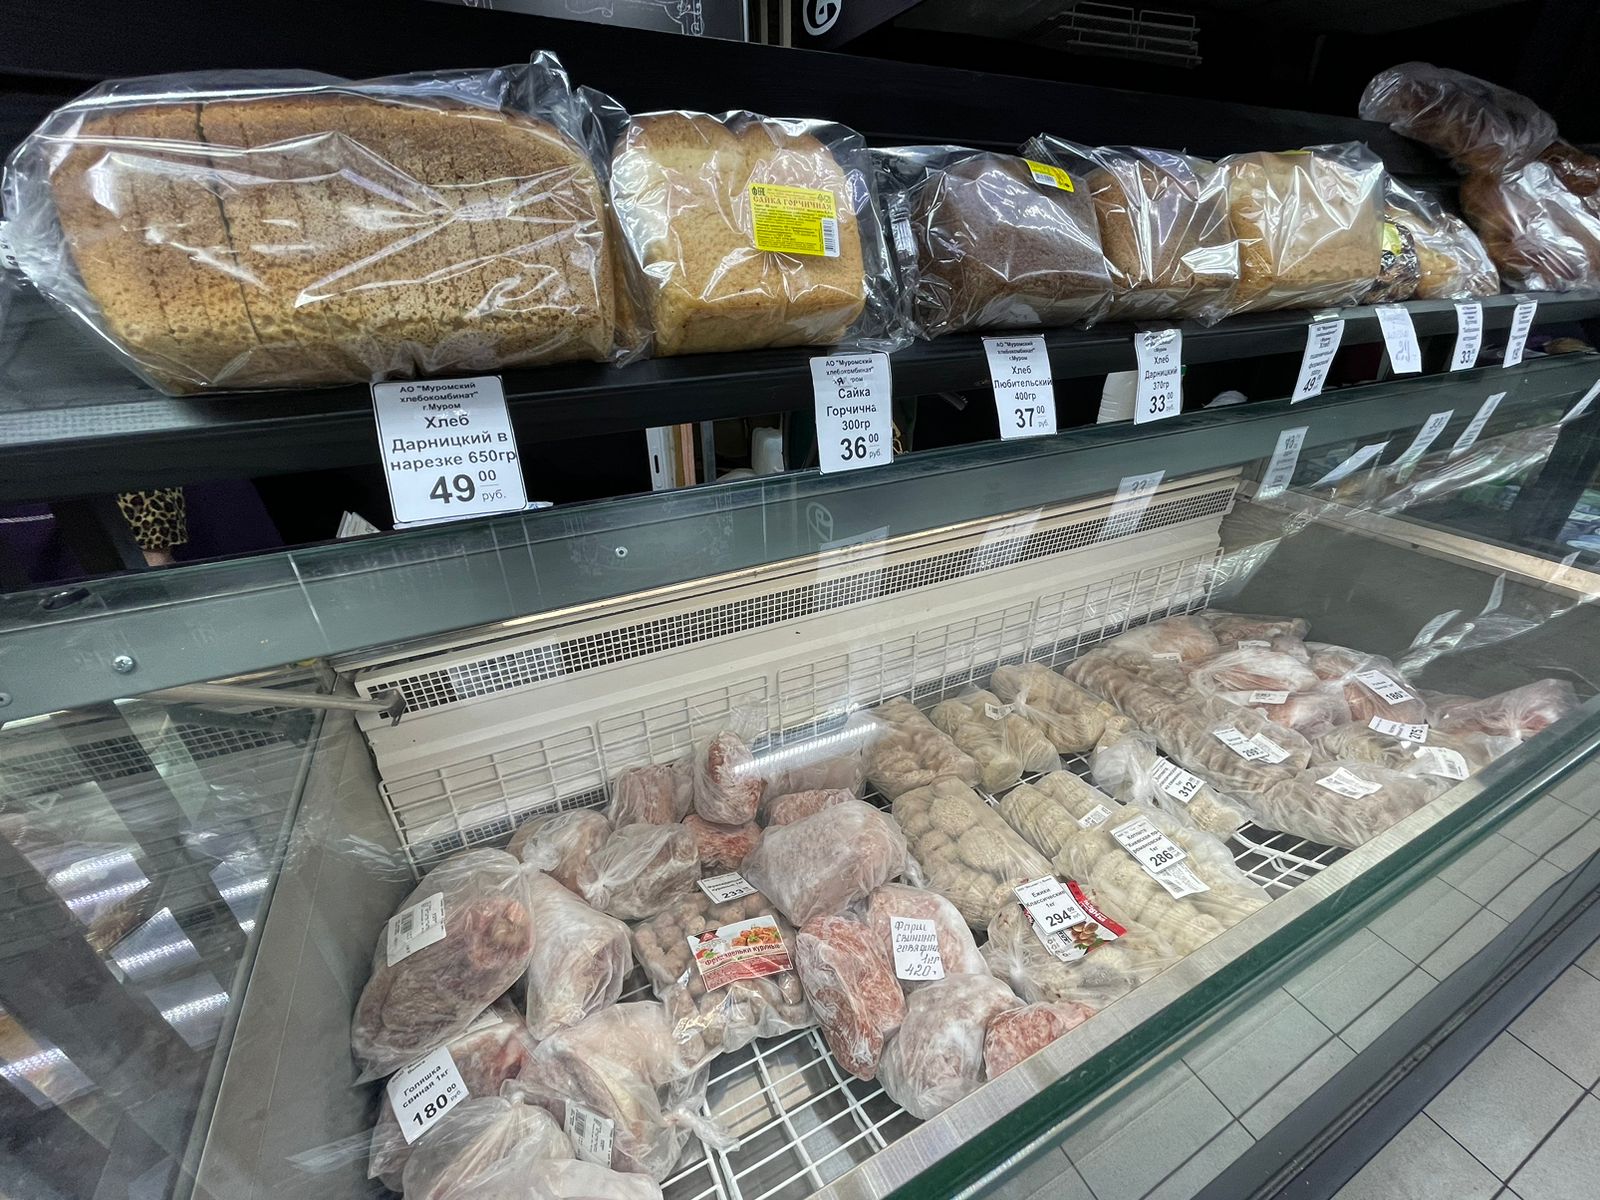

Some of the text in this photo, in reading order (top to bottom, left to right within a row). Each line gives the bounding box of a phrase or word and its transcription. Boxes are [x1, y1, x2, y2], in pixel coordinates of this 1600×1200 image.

[836, 358, 873, 367] "Муромский
[1153, 354, 1170, 365] Хлеб
[1460, 350, 1471, 364] 33
[1011, 365, 1032, 375] Хлеб
[1144, 366, 1178, 380] Дарницкий
[400, 382, 476, 393] АО "Муромский
[994, 377, 1053, 389] Любительский
[400, 391, 479, 403] хлебокомбинат"
[838, 387, 871, 399] Сайка
[1015, 391, 1037, 402] 400гр
[422, 402, 461, 412] г.Муром
[1149, 394, 1166, 414] 33
[424, 413, 470, 429] Хлеб
[1014, 405, 1045, 428] 37 00
[842, 419, 871, 431] 300гр
[392, 431, 508, 454] Дарницкий в
[840, 433, 879, 461] 36 00
[390, 449, 516, 472] нарезке 650гр
[429, 469, 497, 504] 49 00
[1178, 781, 1197, 797] 312
[1149, 850, 1174, 867] 286
[721, 888, 744, 899] 233
[1031, 888, 1051, 898] Ежики
[1045, 909, 1072, 927] 294
[402, 1068, 449, 1108] свиная 1кг
[412, 1083, 457, 1126] 180 00
